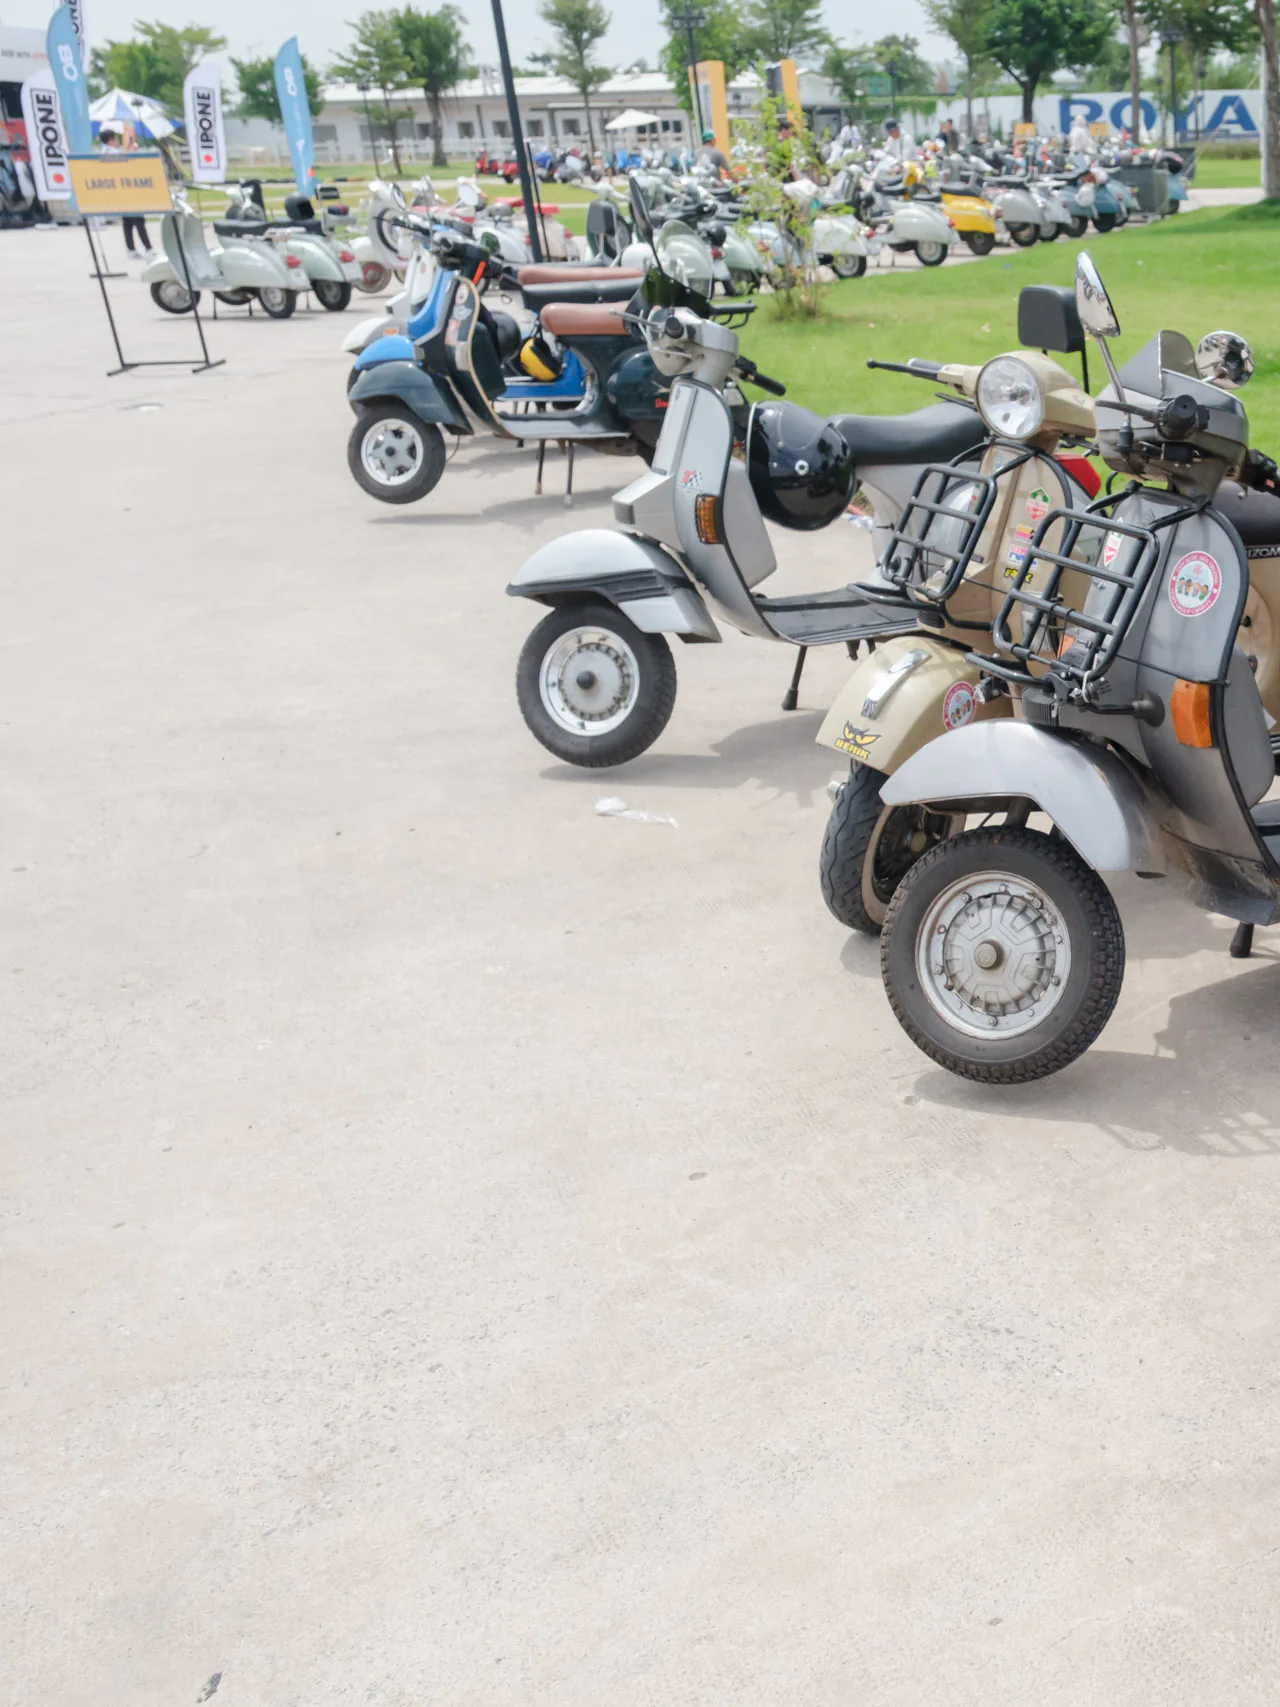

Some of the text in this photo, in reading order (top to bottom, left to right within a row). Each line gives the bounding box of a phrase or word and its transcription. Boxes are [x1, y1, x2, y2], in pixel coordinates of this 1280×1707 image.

[36, 93, 65, 167] IPONE
[197, 91, 215, 149] IPONE
[834, 738, 871, 760] BERIK
